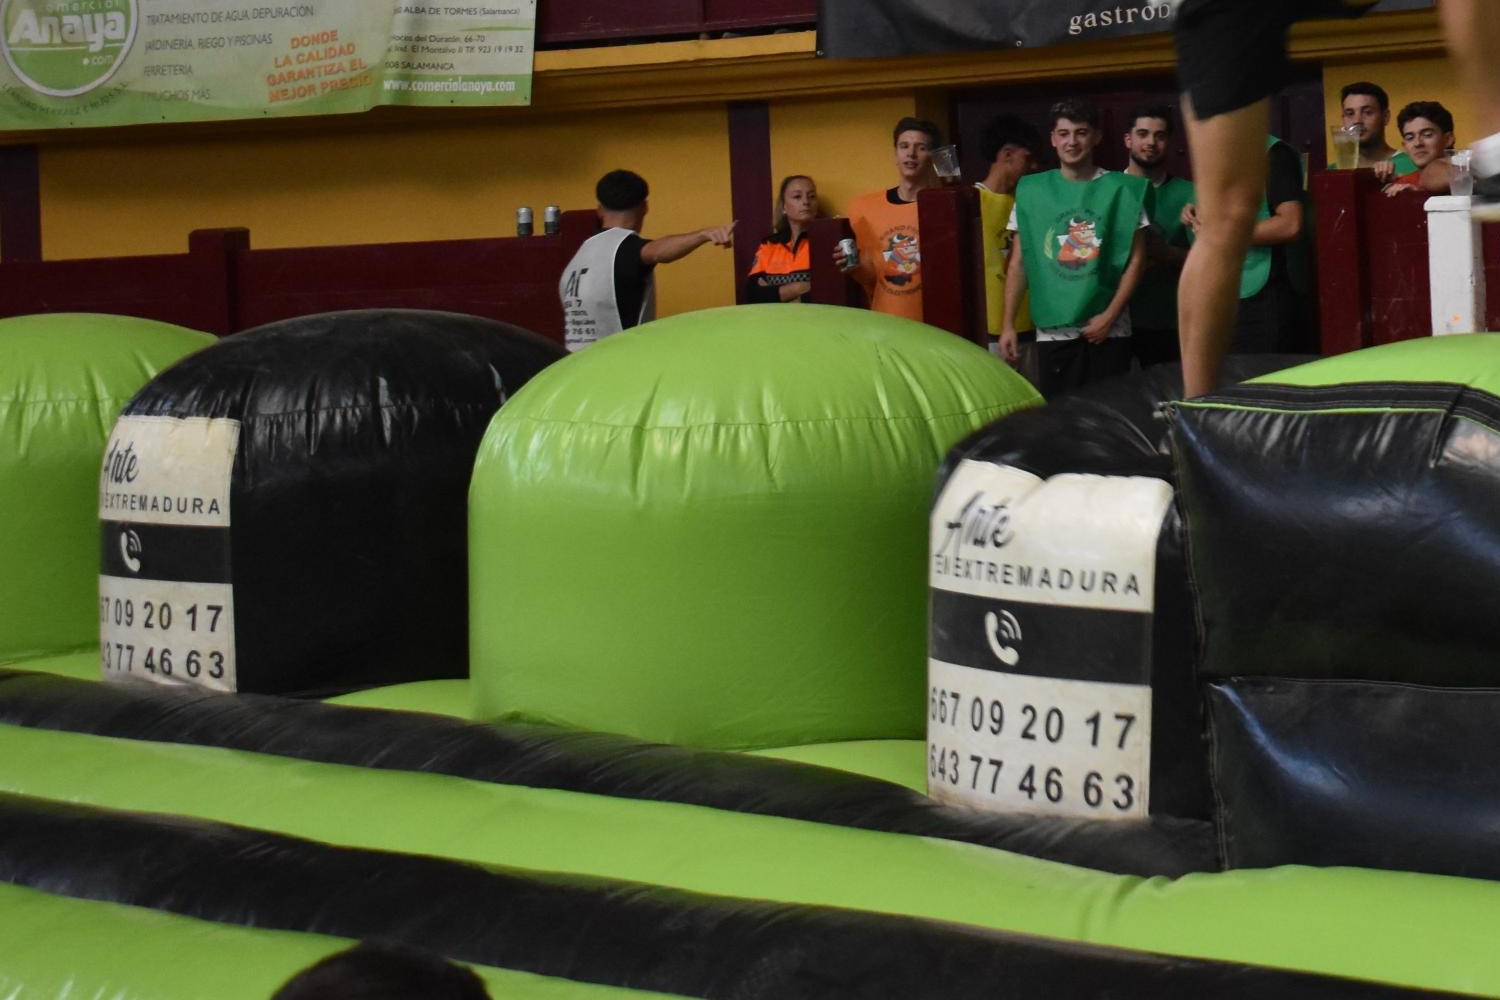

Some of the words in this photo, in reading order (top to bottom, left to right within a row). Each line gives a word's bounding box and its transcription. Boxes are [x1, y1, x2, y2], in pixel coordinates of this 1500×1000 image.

[403, 6, 427, 15] ALBA
[428, 7, 441, 15] DE
[444, 7, 478, 16] TORMES
[8, 8, 126, 53] Anaya
[290, 29, 338, 49] DONDE
[266, 61, 346, 87] GARANTIZA
[349, 57, 368, 72] EL
[274, 55, 293, 69] LA
[295, 42, 357, 65] CALIDAD
[954, 556, 1141, 597] EXTREMADURA
[115, 598, 134, 627] 09
[143, 600, 172, 630] 20
[186, 603, 223, 633] 17
[116, 643, 135, 672] 77
[144, 647, 173, 676] 46
[185, 649, 225, 679] 63
[970, 696, 1005, 736] 09
[1020, 704, 1065, 743] 20
[1085, 711, 1137, 750] 17
[969, 755, 1004, 795] 77
[1018, 764, 1064, 804] 46
[1082, 772, 1135, 812] 63
